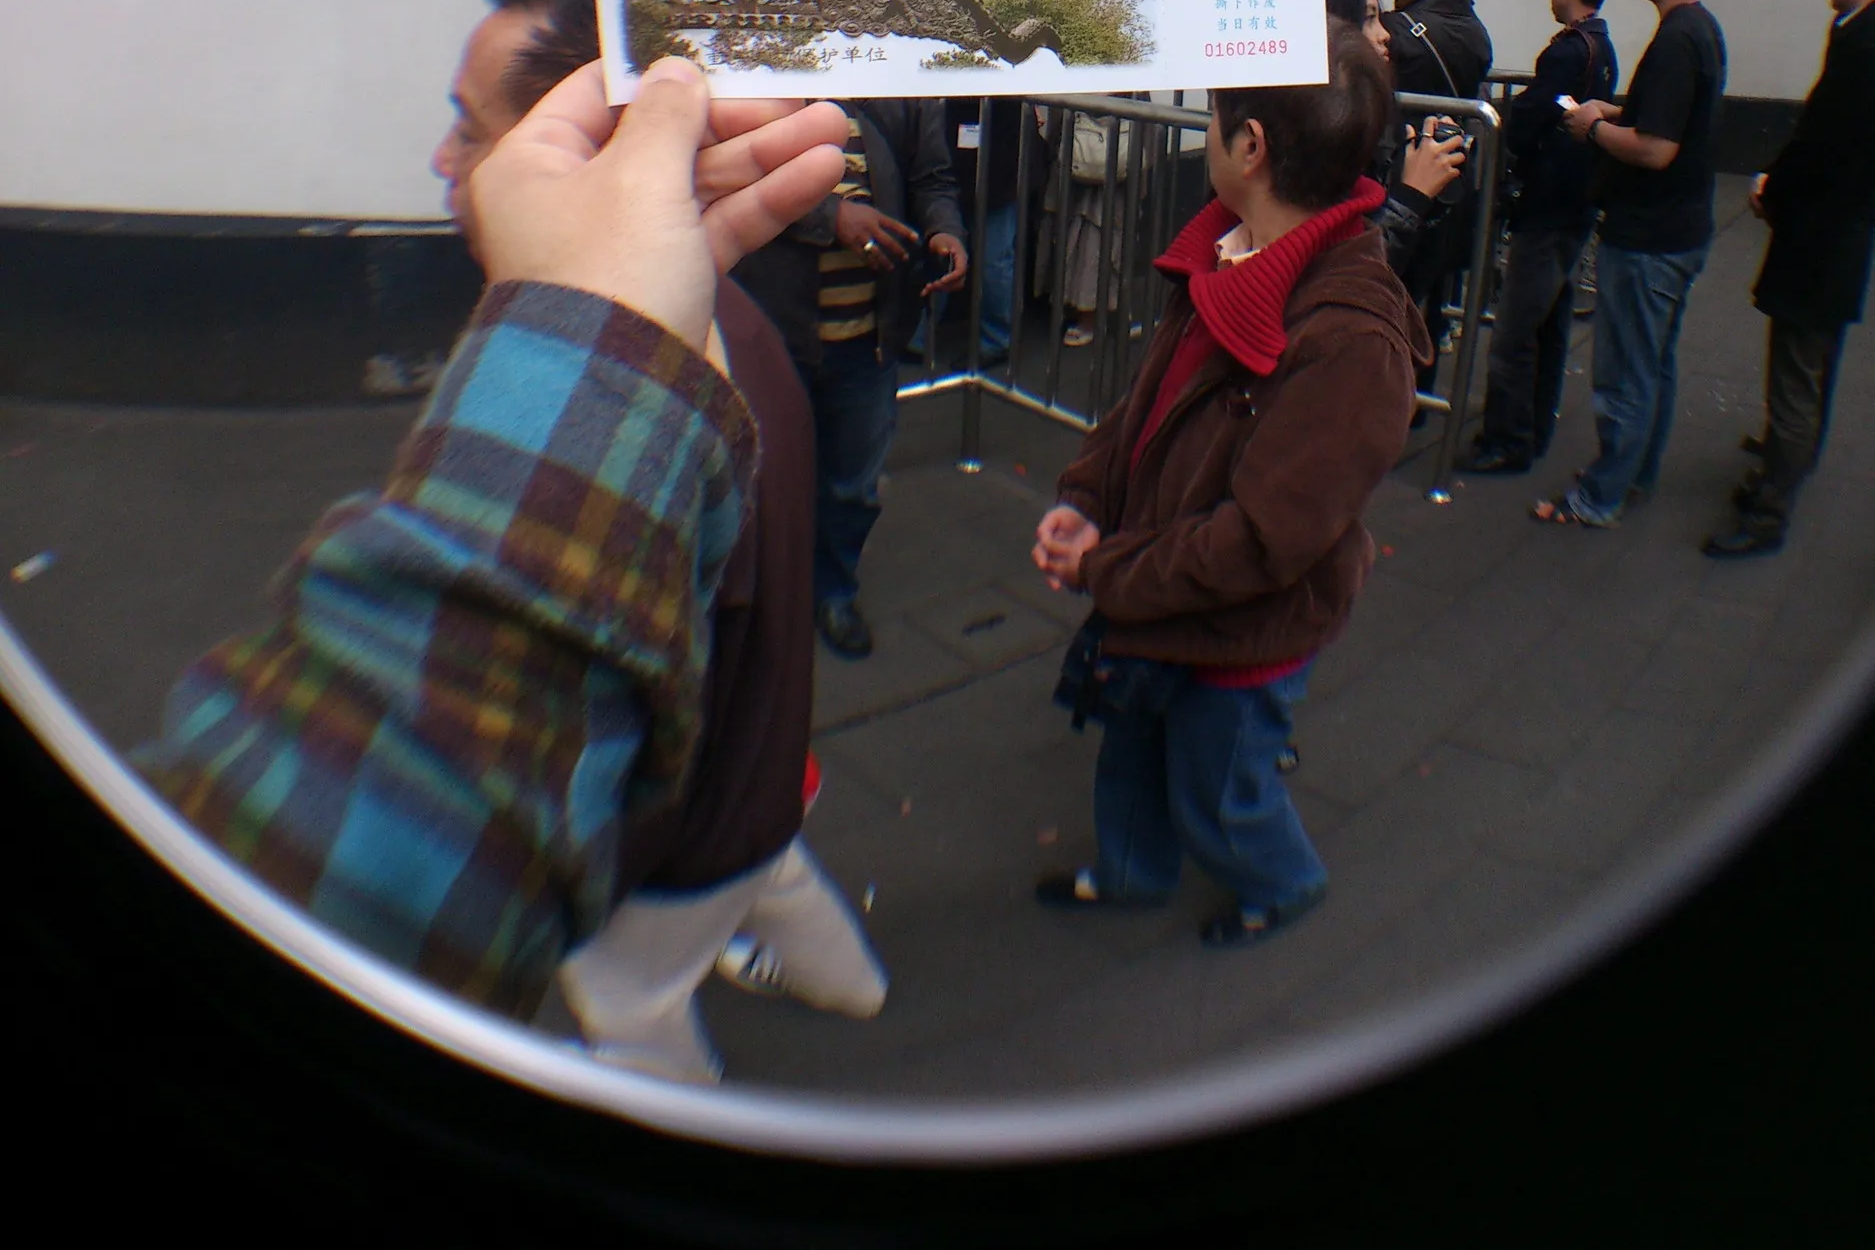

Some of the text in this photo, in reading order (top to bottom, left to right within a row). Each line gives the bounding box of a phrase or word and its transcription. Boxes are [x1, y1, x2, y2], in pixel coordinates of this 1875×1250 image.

[1216, 15, 1277, 31] 当日有效
[1204, 39, 1288, 58] 01602489
